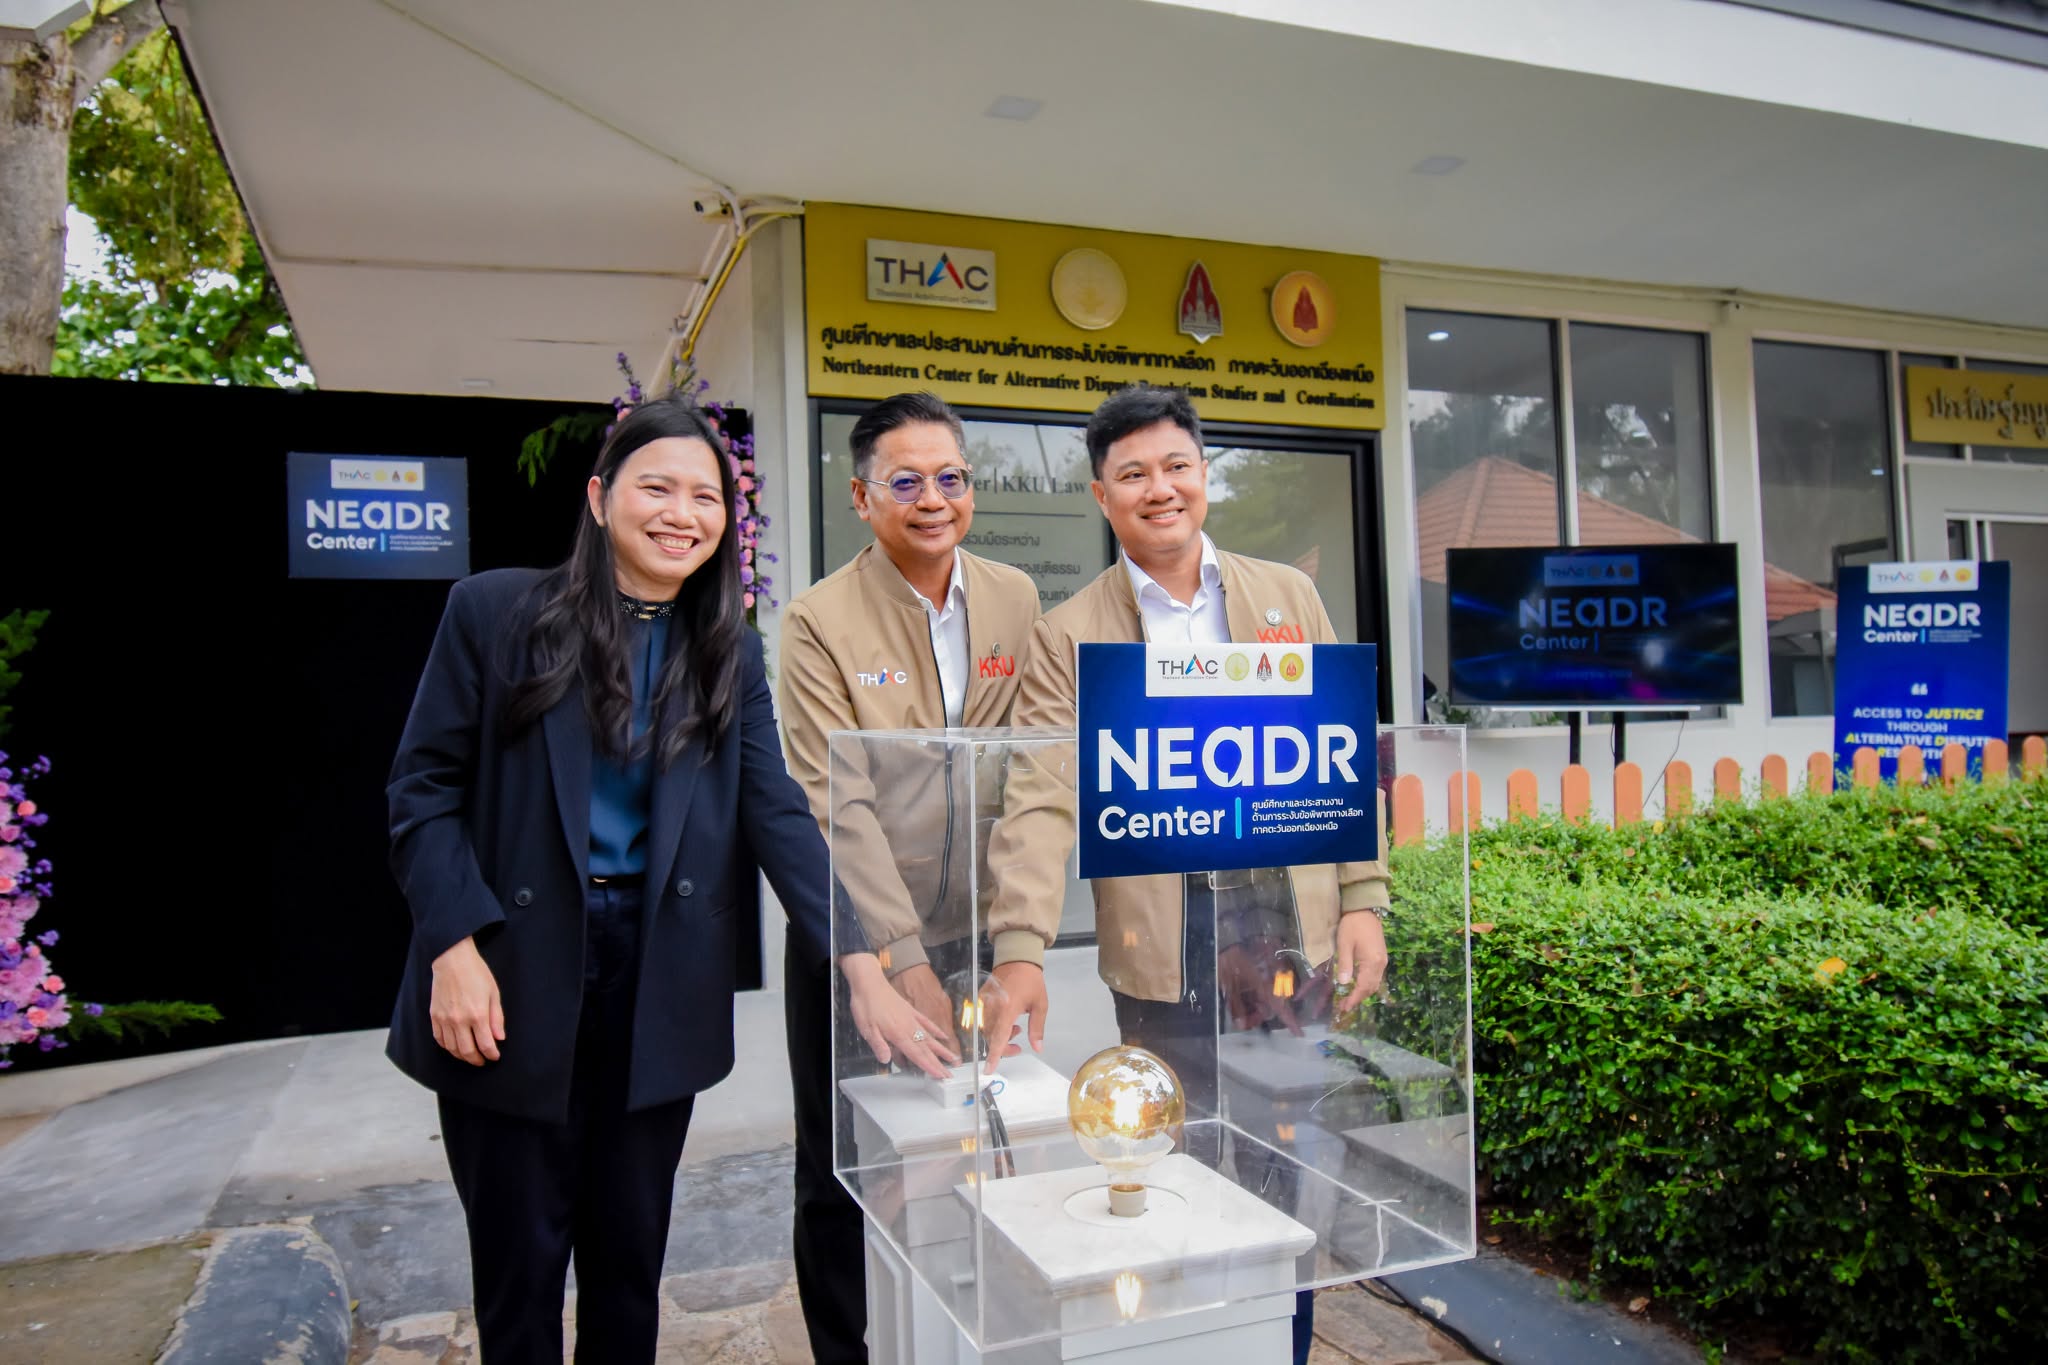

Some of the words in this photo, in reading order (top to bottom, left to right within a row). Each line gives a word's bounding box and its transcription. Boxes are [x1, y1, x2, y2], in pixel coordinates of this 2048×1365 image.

[873, 252, 989, 291] THAC
[822, 356, 920, 379] Northeastern
[924, 364, 973, 383] Center
[978, 368, 999, 385] for
[1004, 371, 1080, 390] Alternative
[1211, 383, 1257, 401] Studies
[1264, 389, 1285, 404] and
[1296, 390, 1375, 409] Coordination
[338, 469, 371, 480] THAC
[1002, 475, 1044, 493] KKU
[1052, 477, 1087, 493] Law
[306, 532, 376, 550] Center
[1256, 624, 1304, 643] KKU
[1519, 633, 1589, 651] Center
[1863, 629, 1919, 643] Center
[979, 655, 1015, 679] KKU
[1157, 653, 1219, 676] THAC
[857, 668, 907, 686] THAC
[1853, 707, 1903, 719] ACCESS
[1905, 707, 1923, 719] TO
[1924, 708, 1985, 720] JUSTICE
[1886, 721, 1948, 733] THROUGH
[1844, 732, 1933, 745] ALTERNATIVE
[1252, 798, 1344, 812] ศูนย์ศึกษาและประสานงาน
[1098, 804, 1226, 840] Center
[1252, 808, 1364, 822] ด้านการระงับข้อพิพาททางเลือก
[1252, 821, 1339, 834] ภาคตะวันออกเฉียงเหนือ
